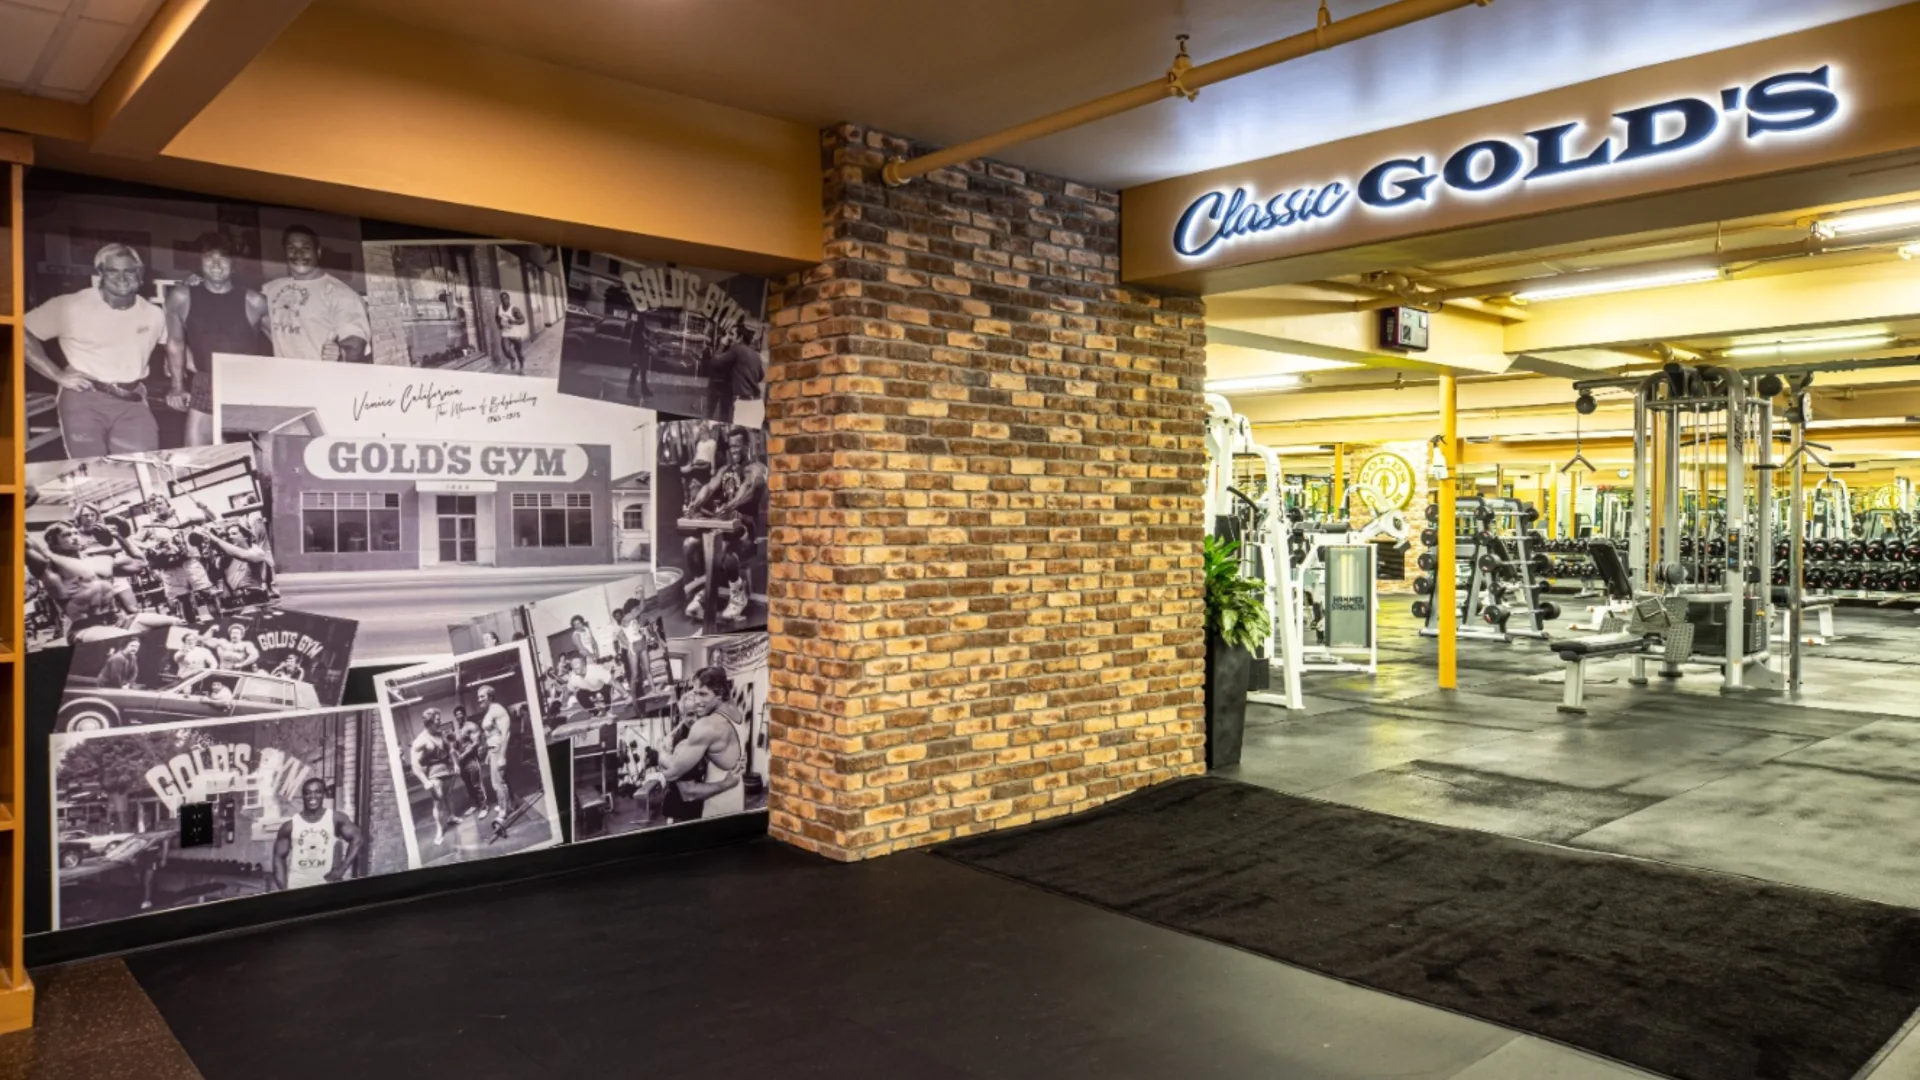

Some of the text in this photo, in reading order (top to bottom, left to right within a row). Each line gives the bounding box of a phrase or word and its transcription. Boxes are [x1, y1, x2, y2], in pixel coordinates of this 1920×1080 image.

[1173, 64, 1840, 257] Classic GOLD'S
[622, 267, 750, 330] GOLD'S GYM
[353, 382, 463, 421] Venice California
[328, 441, 567, 477] GOLD'S GYM
[257, 630, 324, 659] GOLD'S GYM
[144, 742, 252, 806] GOLD'S
[298, 859, 326, 868] GYM
